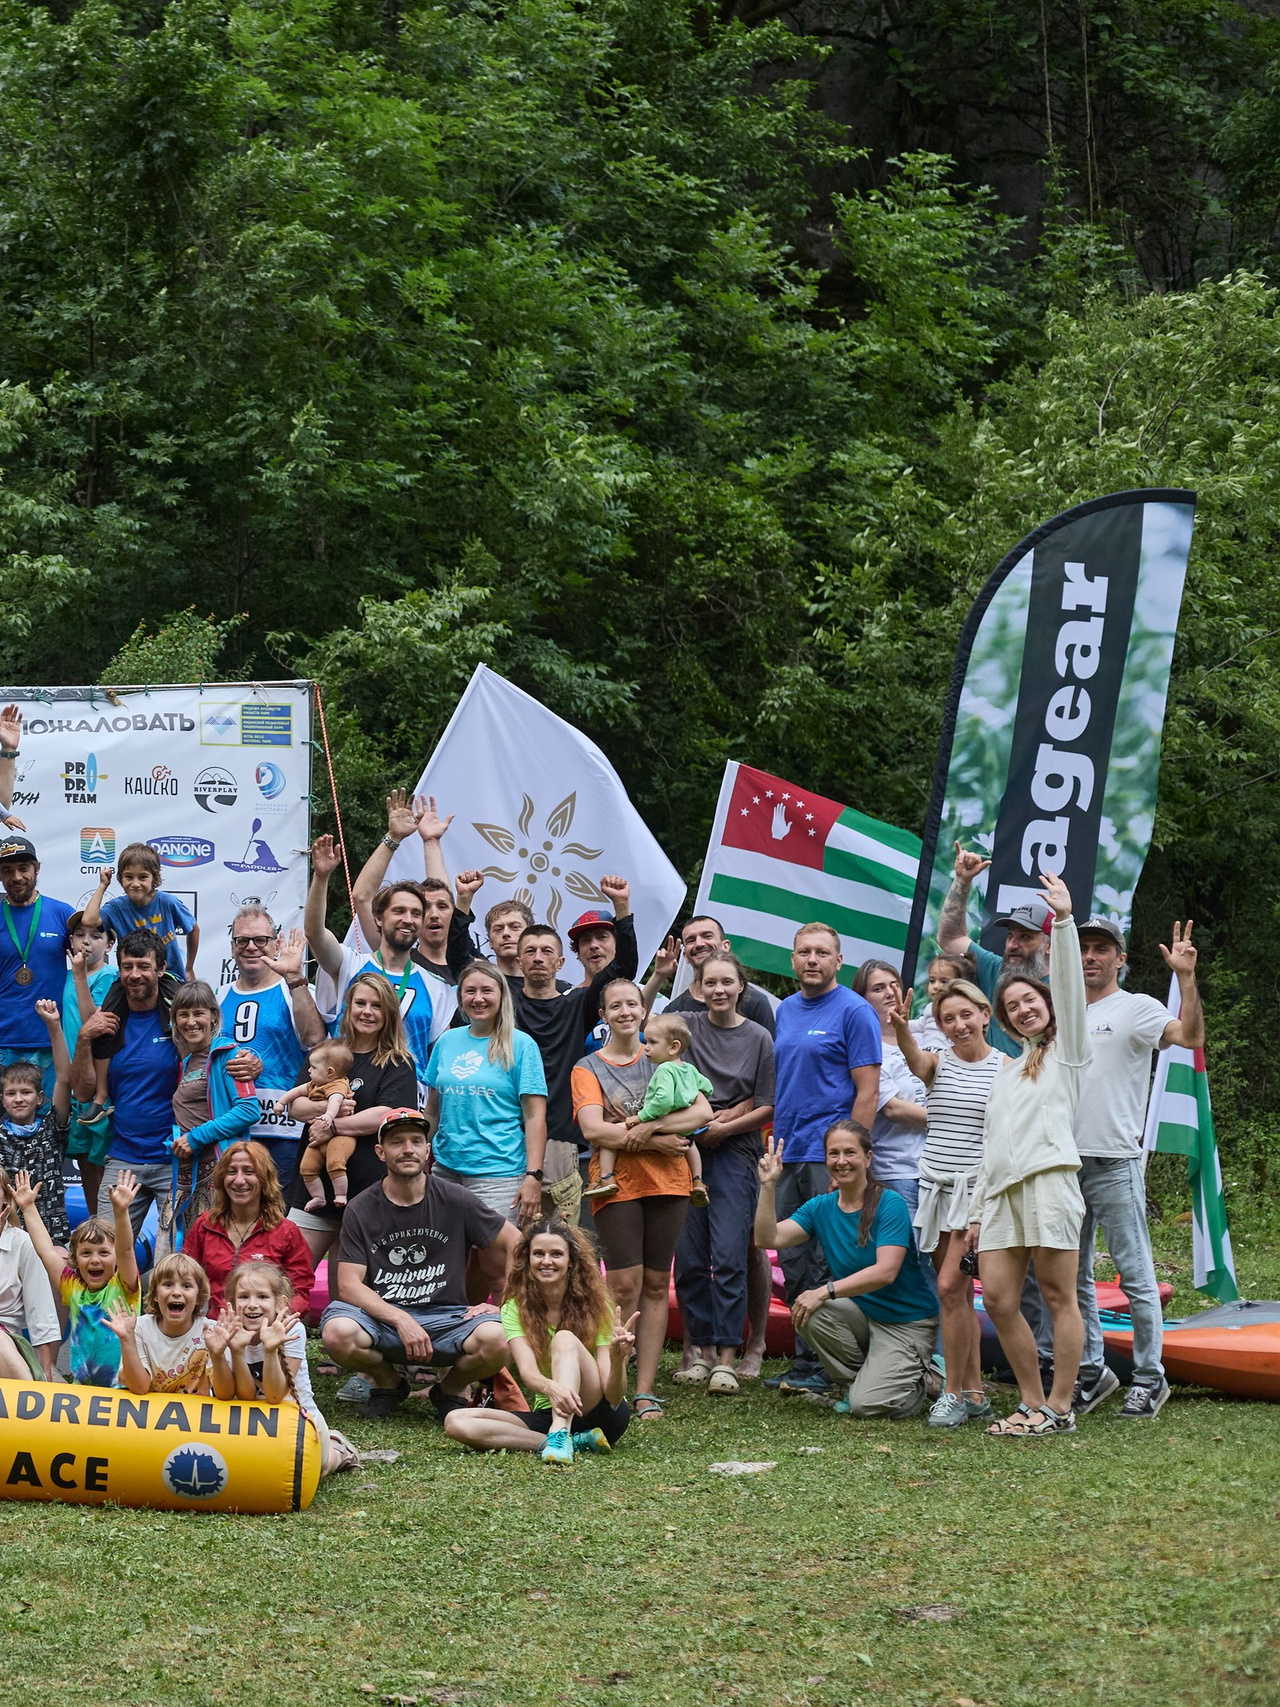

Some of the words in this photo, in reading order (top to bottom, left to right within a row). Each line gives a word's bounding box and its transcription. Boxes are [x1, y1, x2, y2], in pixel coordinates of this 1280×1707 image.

[65, 794, 97, 804] TEAM
[81, 866, 116, 874] СПЛВ
[233, 1000, 260, 1043] 9
[468, 1085, 495, 1098] SEE
[259, 1113, 297, 1127] 2025
[374, 1263, 446, 1285] Lenivaya
